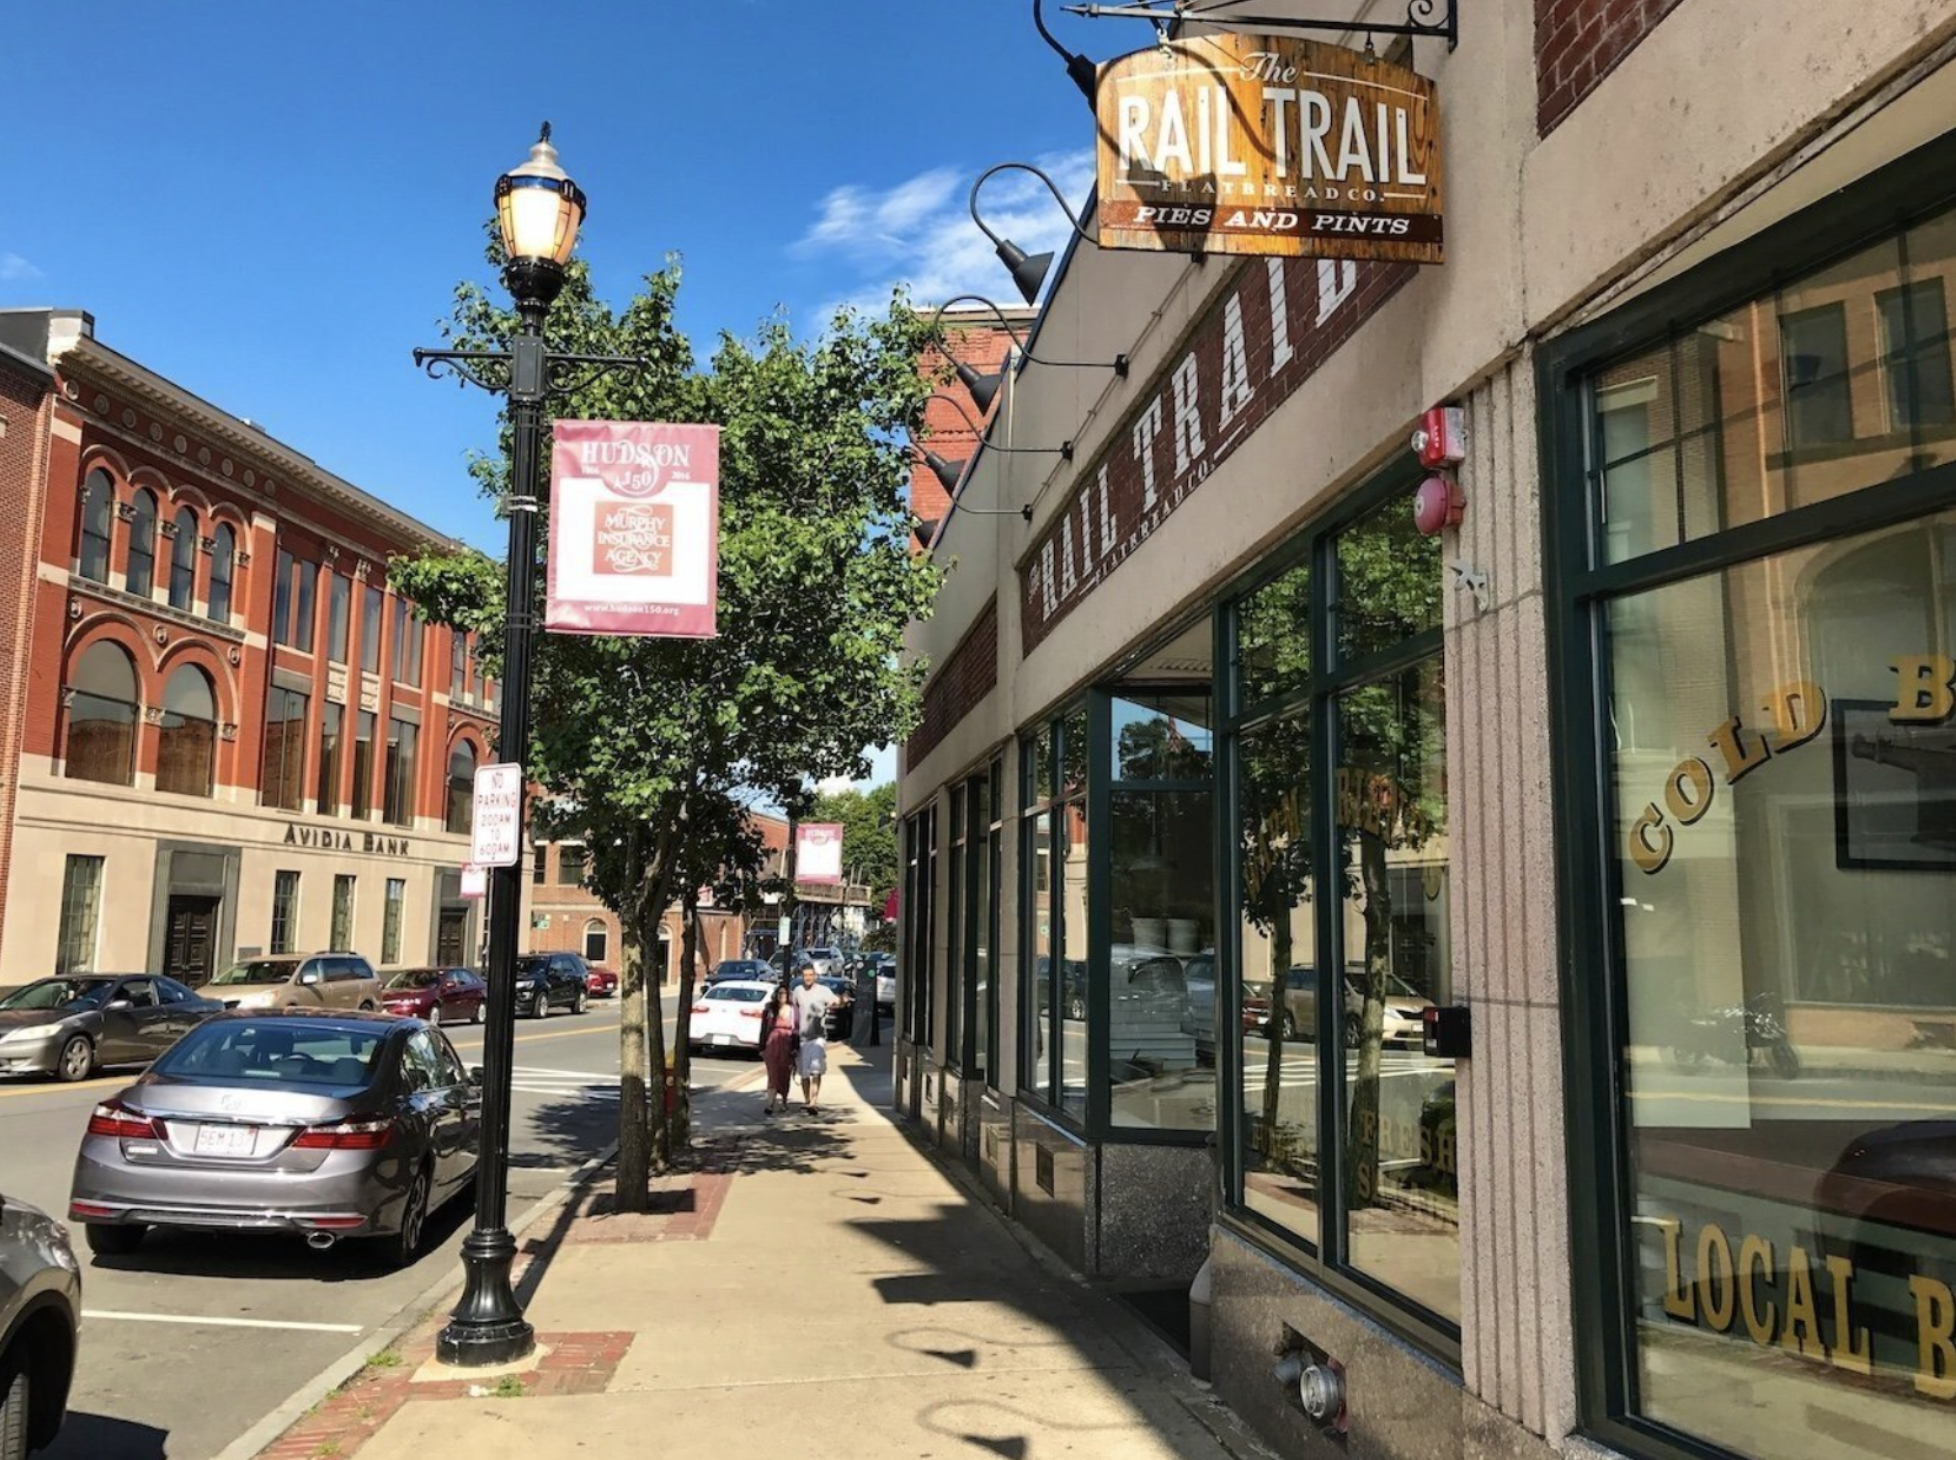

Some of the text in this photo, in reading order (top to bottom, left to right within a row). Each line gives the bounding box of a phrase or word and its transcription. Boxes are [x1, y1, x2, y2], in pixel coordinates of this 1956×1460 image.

[1239, 52, 1298, 83] The
[1117, 86, 1427, 185] RAIL TRAIL
[1160, 179, 1340, 200] FLATBREAD
[1133, 208, 1411, 235] PIES AND PINTS
[580, 440, 691, 468] HUDSON
[598, 531, 671, 548] INSURANCE
[1041, 463, 1117, 622] RAIL
[1629, 680, 1827, 874] COLD
[284, 823, 409, 855] AVIDIA BANK
[1362, 1109, 1456, 1175] FRESH
[1660, 1215, 1873, 1376] LOCAL
